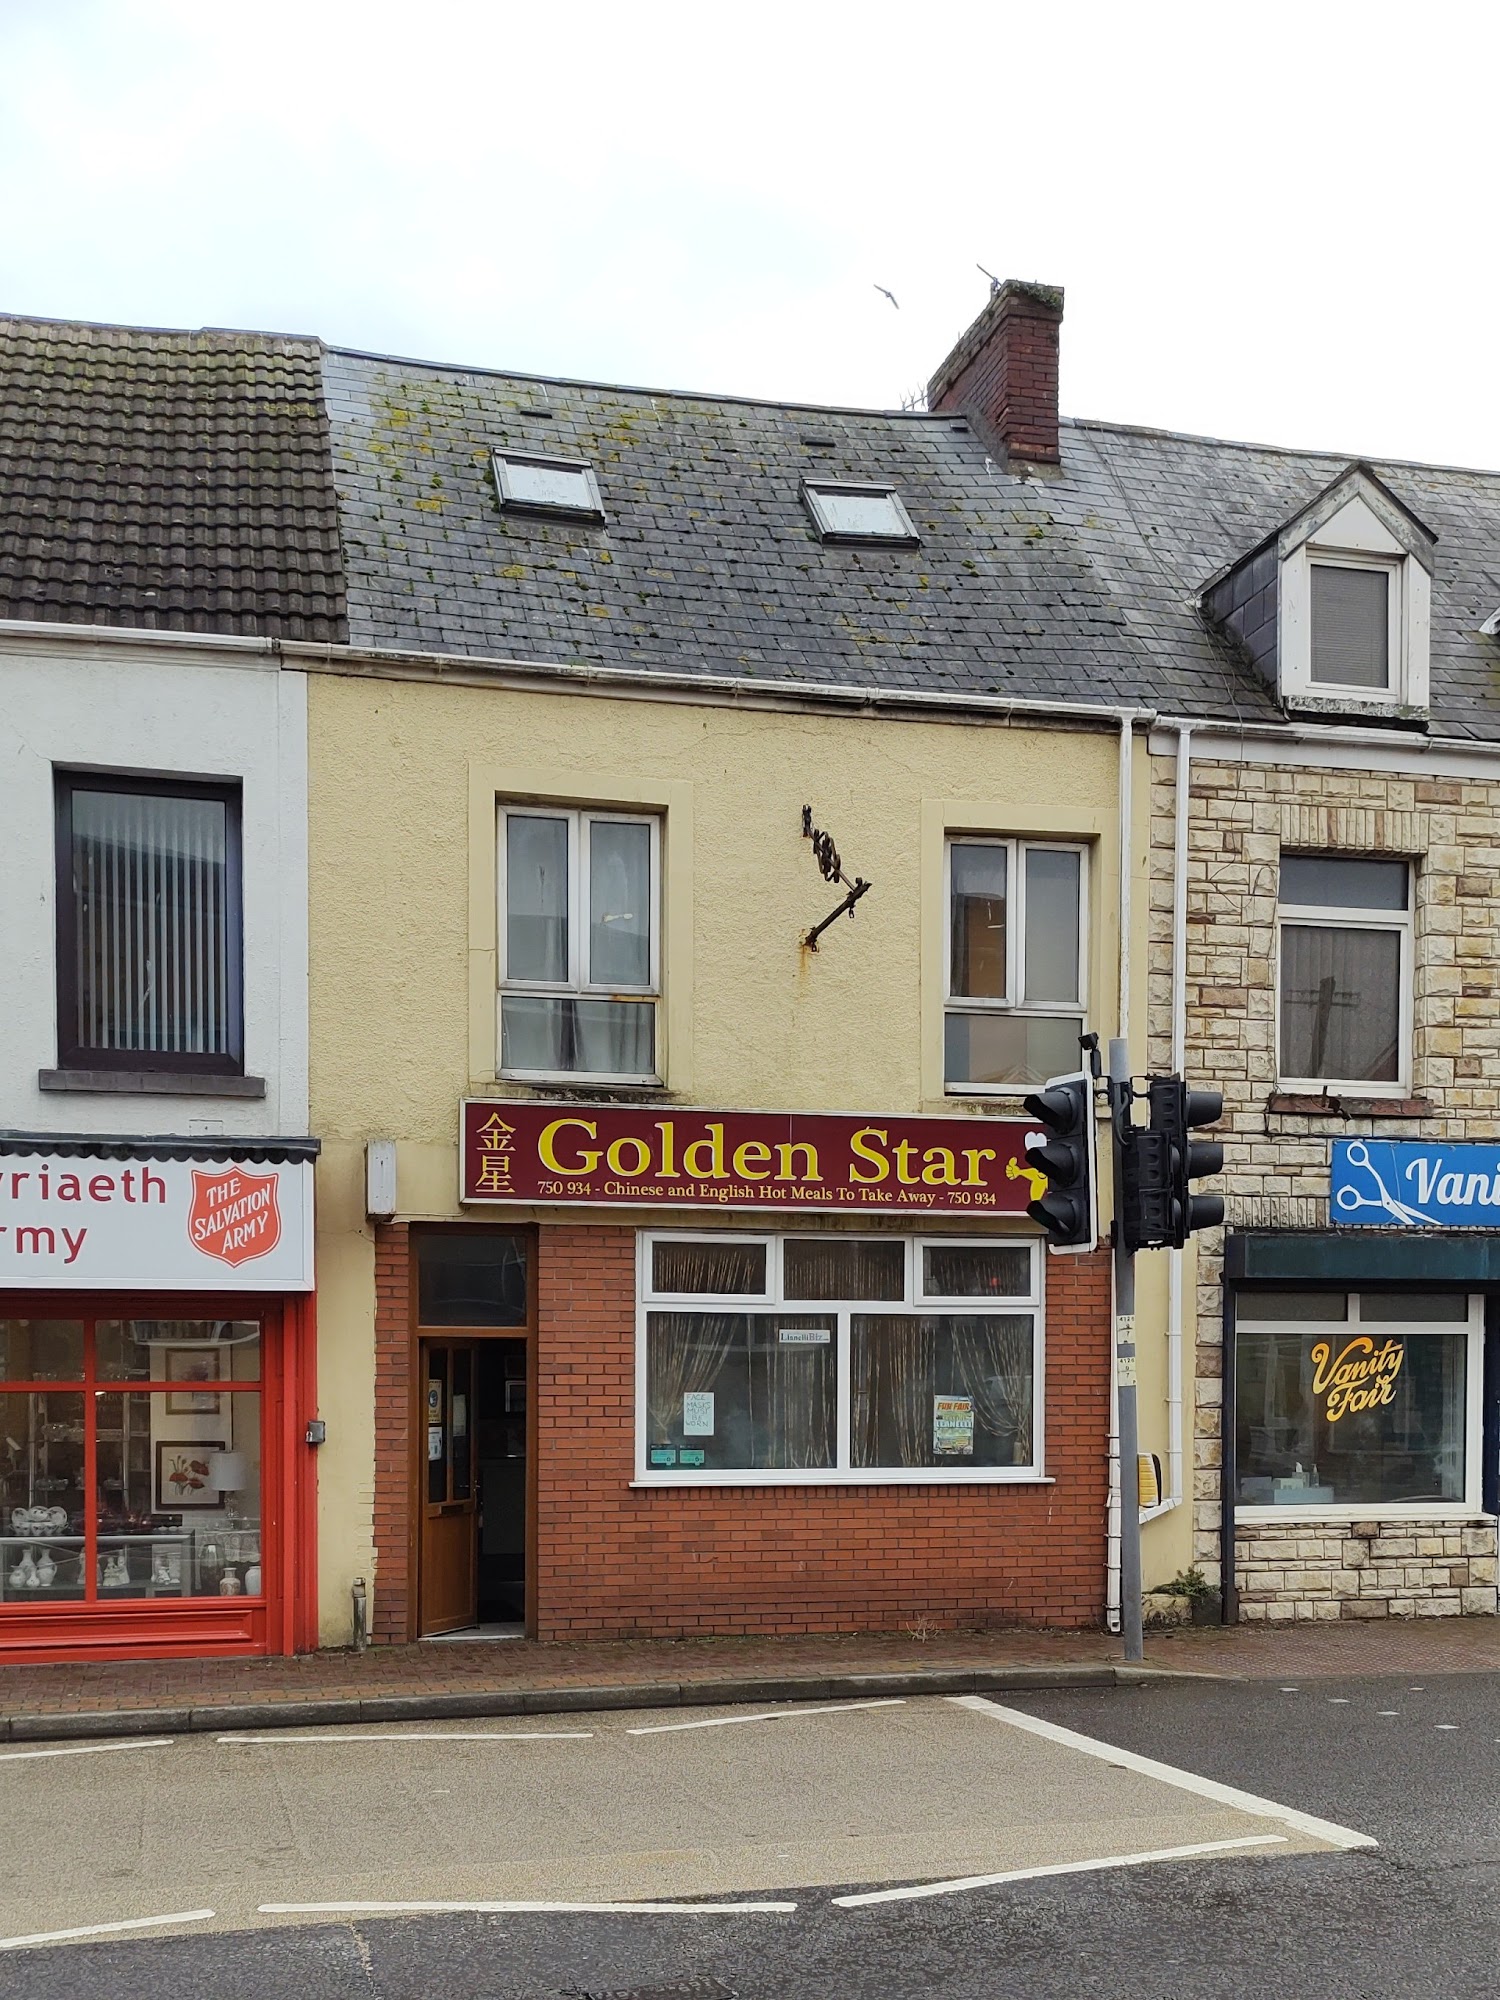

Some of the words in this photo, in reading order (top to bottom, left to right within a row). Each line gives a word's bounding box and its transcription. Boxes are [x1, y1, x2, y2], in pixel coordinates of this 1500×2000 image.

[475, 1111, 517, 1193] 金星
[537, 1118, 823, 1182] Golden
[848, 1125, 997, 1187] Star
[0, 1163, 166, 1204] riaeth
[206, 1177, 242, 1208] THE
[537, 1180, 564, 1195] 750
[567, 1181, 592, 1196] 934
[603, 1181, 664, 1197] Chinese
[668, 1183, 696, 1198] and
[699, 1183, 754, 1203] English
[758, 1185, 788, 1200] Hot
[790, 1185, 834, 1201] Meals
[836, 1187, 856, 1202] To
[858, 1187, 893, 1203] Take
[896, 1189, 937, 1208] Away
[947, 1191, 971, 1205] 750
[974, 1192, 997, 1206] 934
[194, 1183, 271, 1241] SALVATION
[221, 1210, 269, 1255] ARMY
[0, 1226, 88, 1265] my
[1311, 1336, 1404, 1395] Vanity
[1326, 1375, 1397, 1421] Fair
